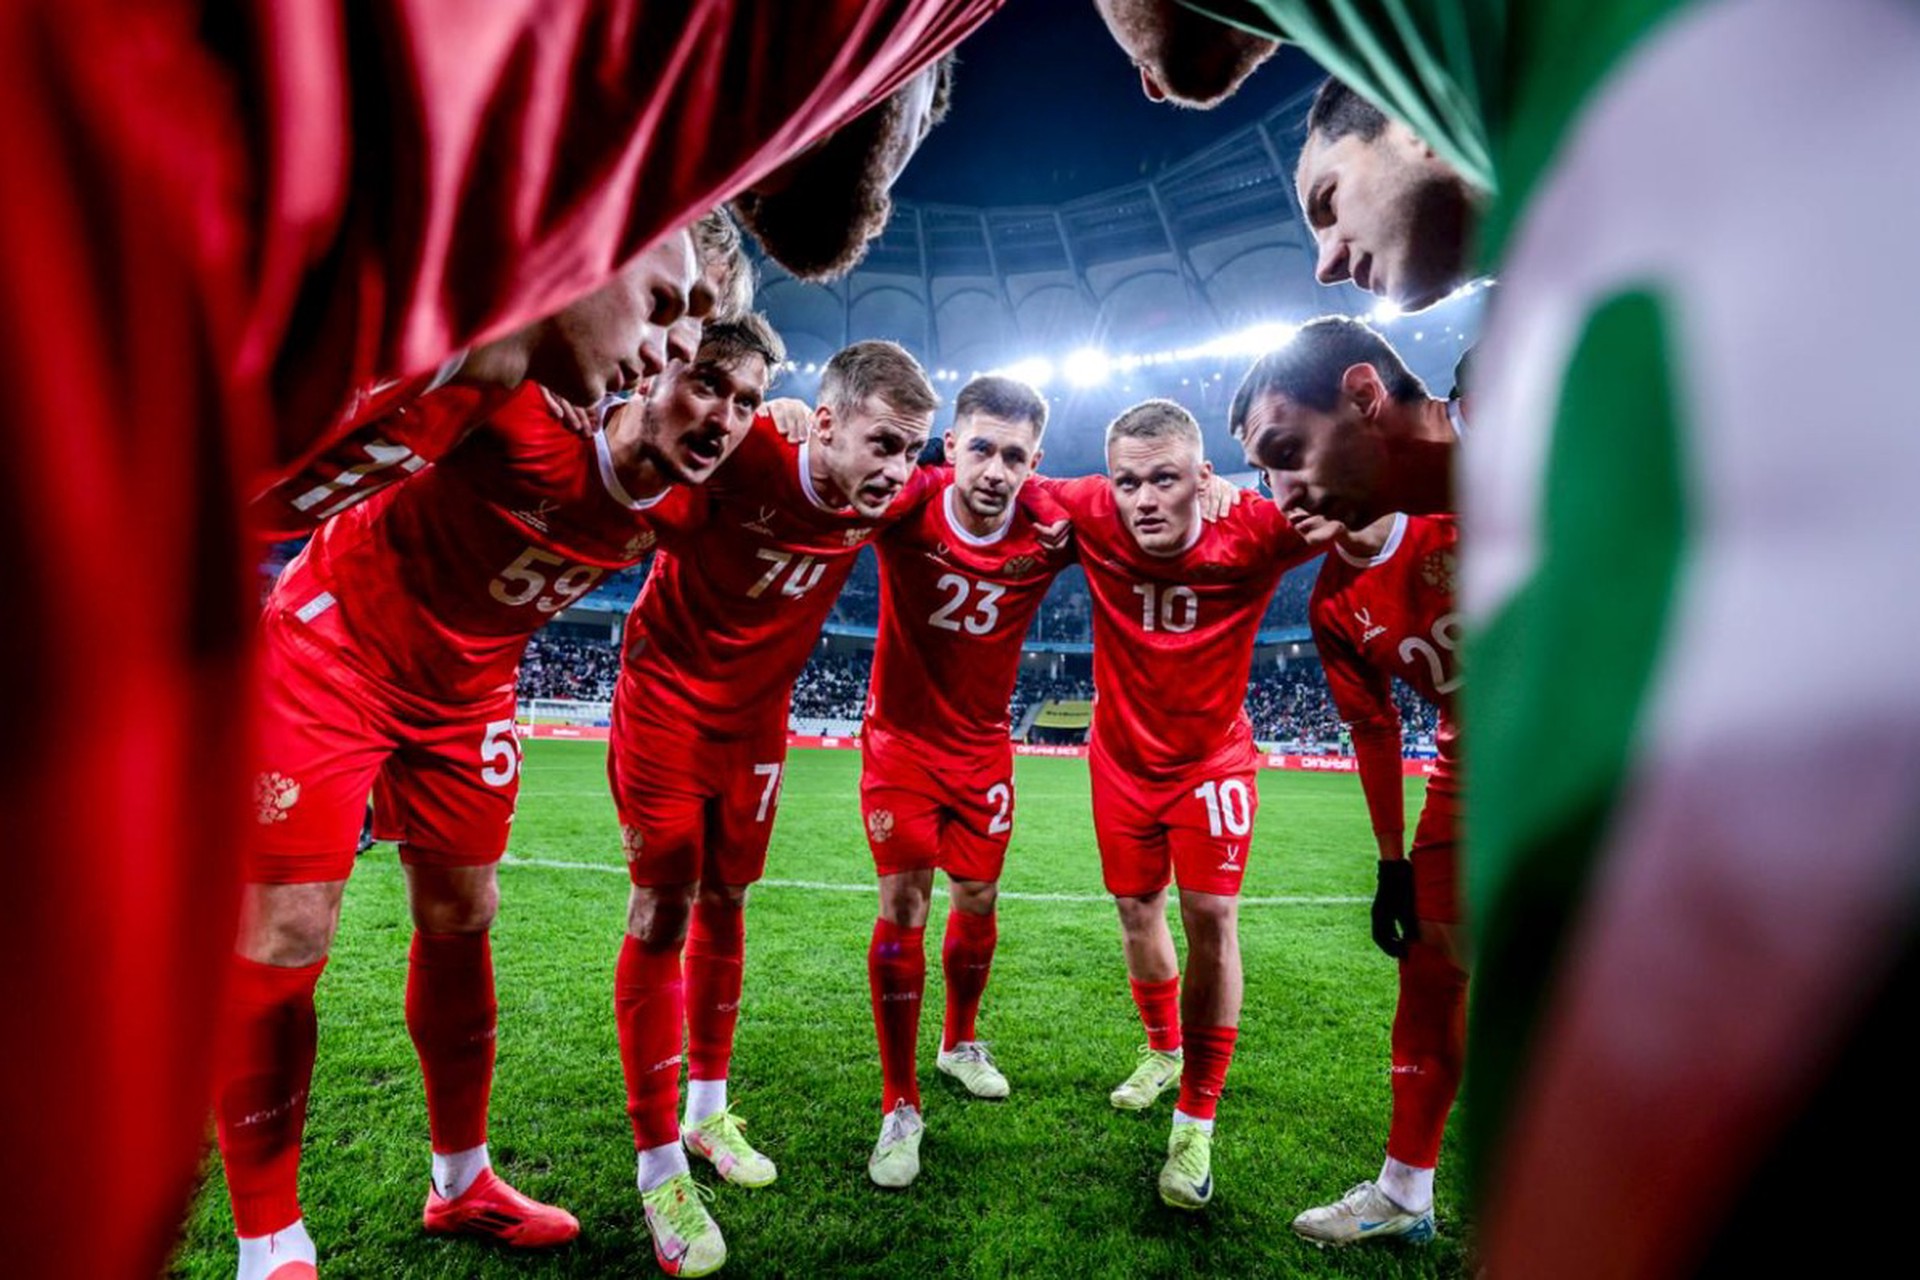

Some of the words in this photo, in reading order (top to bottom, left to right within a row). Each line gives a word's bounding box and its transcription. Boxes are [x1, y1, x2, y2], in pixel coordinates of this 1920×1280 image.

[489, 545, 604, 612] 59
[746, 548, 827, 600] 74
[928, 573, 1007, 635] 23
[1133, 583, 1198, 633] 10
[481, 719, 521, 787] 5
[754, 763, 785, 822] 7
[986, 782, 1014, 835] 2
[1194, 779, 1251, 837] 10
